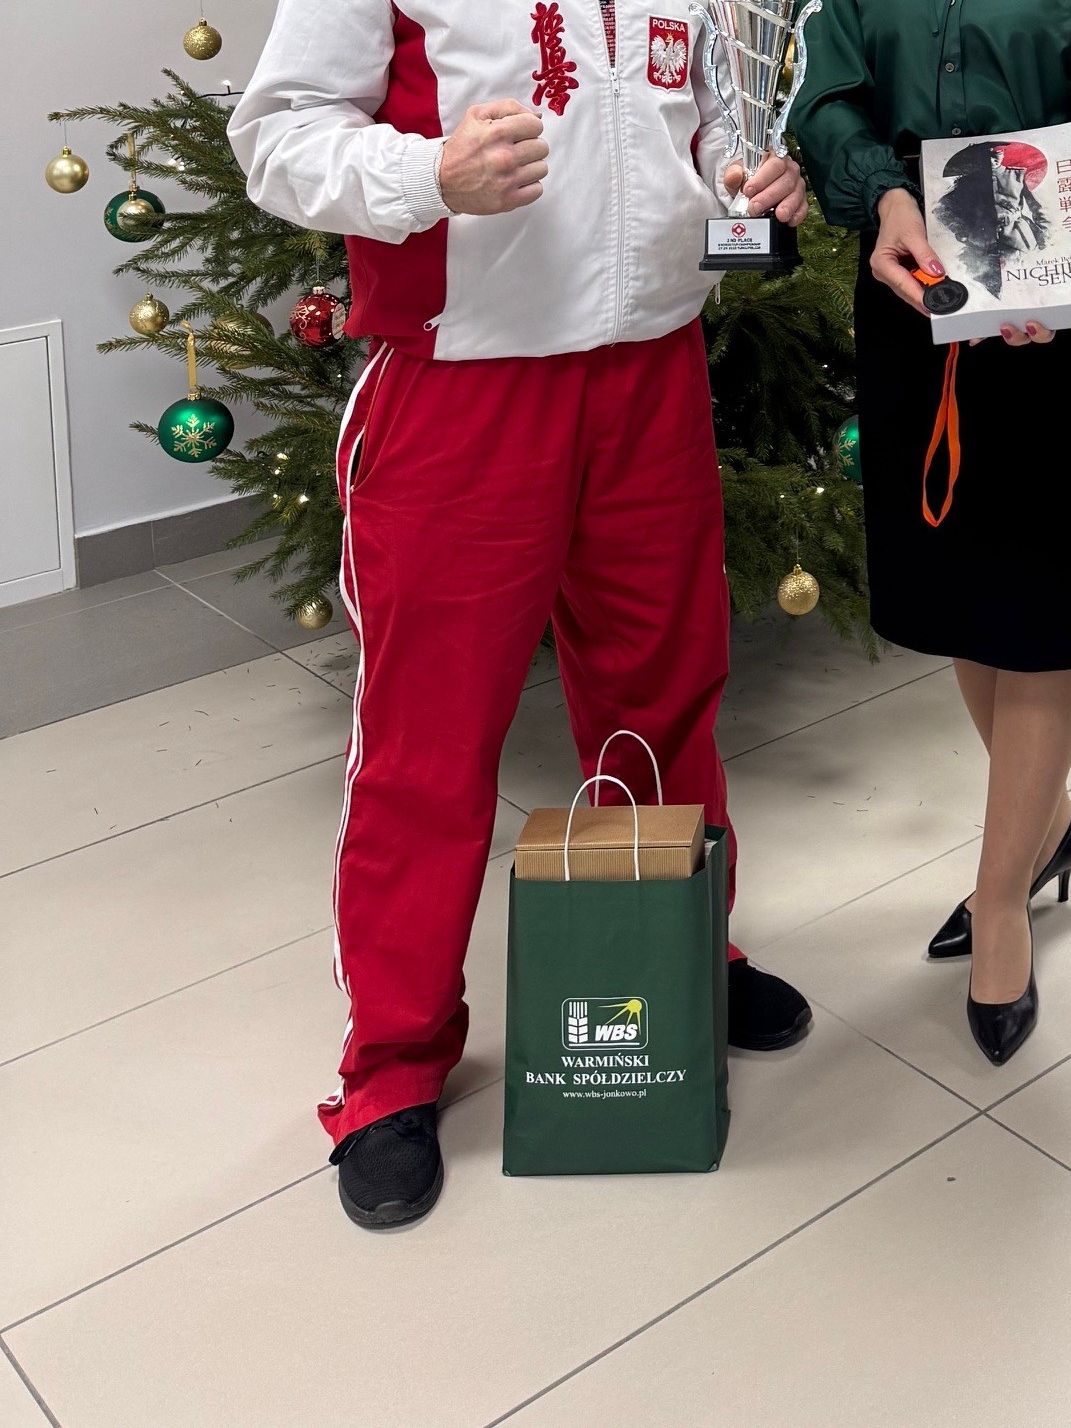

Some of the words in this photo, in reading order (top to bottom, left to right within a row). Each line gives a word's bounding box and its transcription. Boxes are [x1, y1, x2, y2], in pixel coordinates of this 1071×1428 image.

[652, 18, 686, 33] POLSKA
[1036, 258, 1059, 267] Marek
[595, 1024, 639, 1042] WBS
[561, 1053, 650, 1068] WARMIŃSKI
[525, 1071, 567, 1086] BANK
[572, 1069, 687, 1085] SPÓŁDZIELCZY
[562, 1088, 648, 1100] www.wbs-jonkowo.pl
